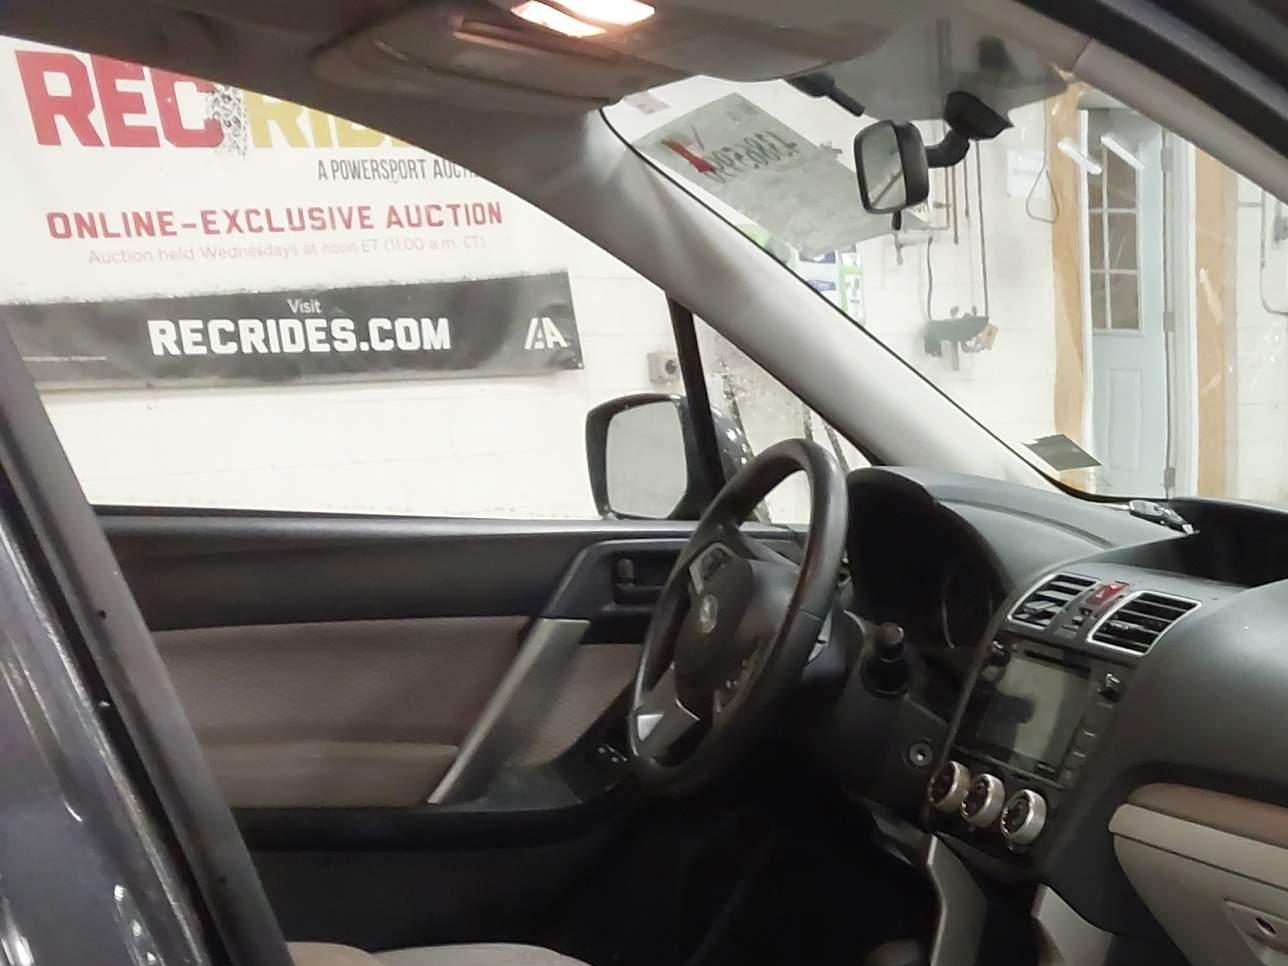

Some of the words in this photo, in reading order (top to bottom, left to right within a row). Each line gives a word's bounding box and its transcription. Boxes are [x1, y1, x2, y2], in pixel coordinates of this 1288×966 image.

[318, 159, 328, 180] A
[330, 159, 426, 181] POWERSPORT
[433, 159, 480, 179] AUC
[46, 205, 375, 240] ONLINE-EXCLUSIVE
[386, 201, 503, 229] AUCTION
[88, 250, 154, 265] Auction
[159, 246, 195, 262] held
[202, 242, 299, 260] Wednesdays
[303, 241, 318, 256] at
[361, 239, 378, 253] ET
[287, 299, 322, 314] Visit
[147, 317, 451, 356] RECRIDES.COM
